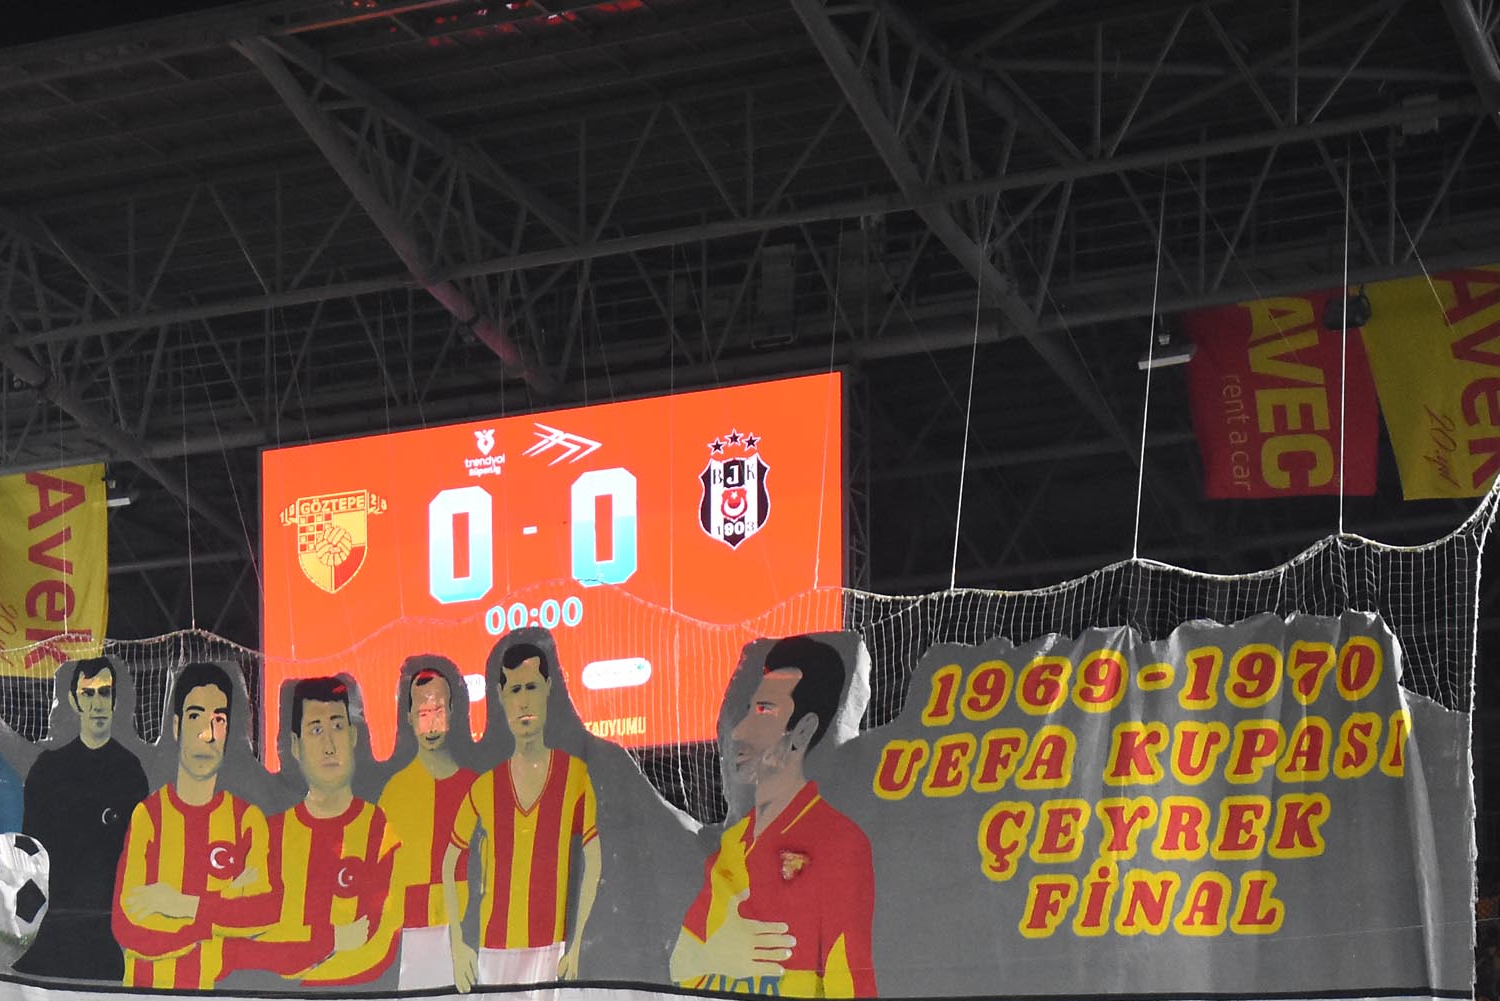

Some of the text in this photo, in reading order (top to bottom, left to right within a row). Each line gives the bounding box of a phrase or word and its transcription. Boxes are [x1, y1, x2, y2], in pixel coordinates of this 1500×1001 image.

[1221, 375, 1251, 491] rent a car
[1240, 297, 1334, 489] AVEC
[300, 495, 365, 513] GÖZTEPE
[429, 486, 493, 604] 0
[571, 467, 638, 588] 0
[25, 472, 92, 669] Avek
[485, 596, 583, 636] 00:00
[584, 717, 647, 737] TADYUMU
[875, 712, 1412, 798] UEFA KUPASI
[978, 793, 1332, 881] ÇEYREK
[1020, 857, 1285, 936] FİNAL
